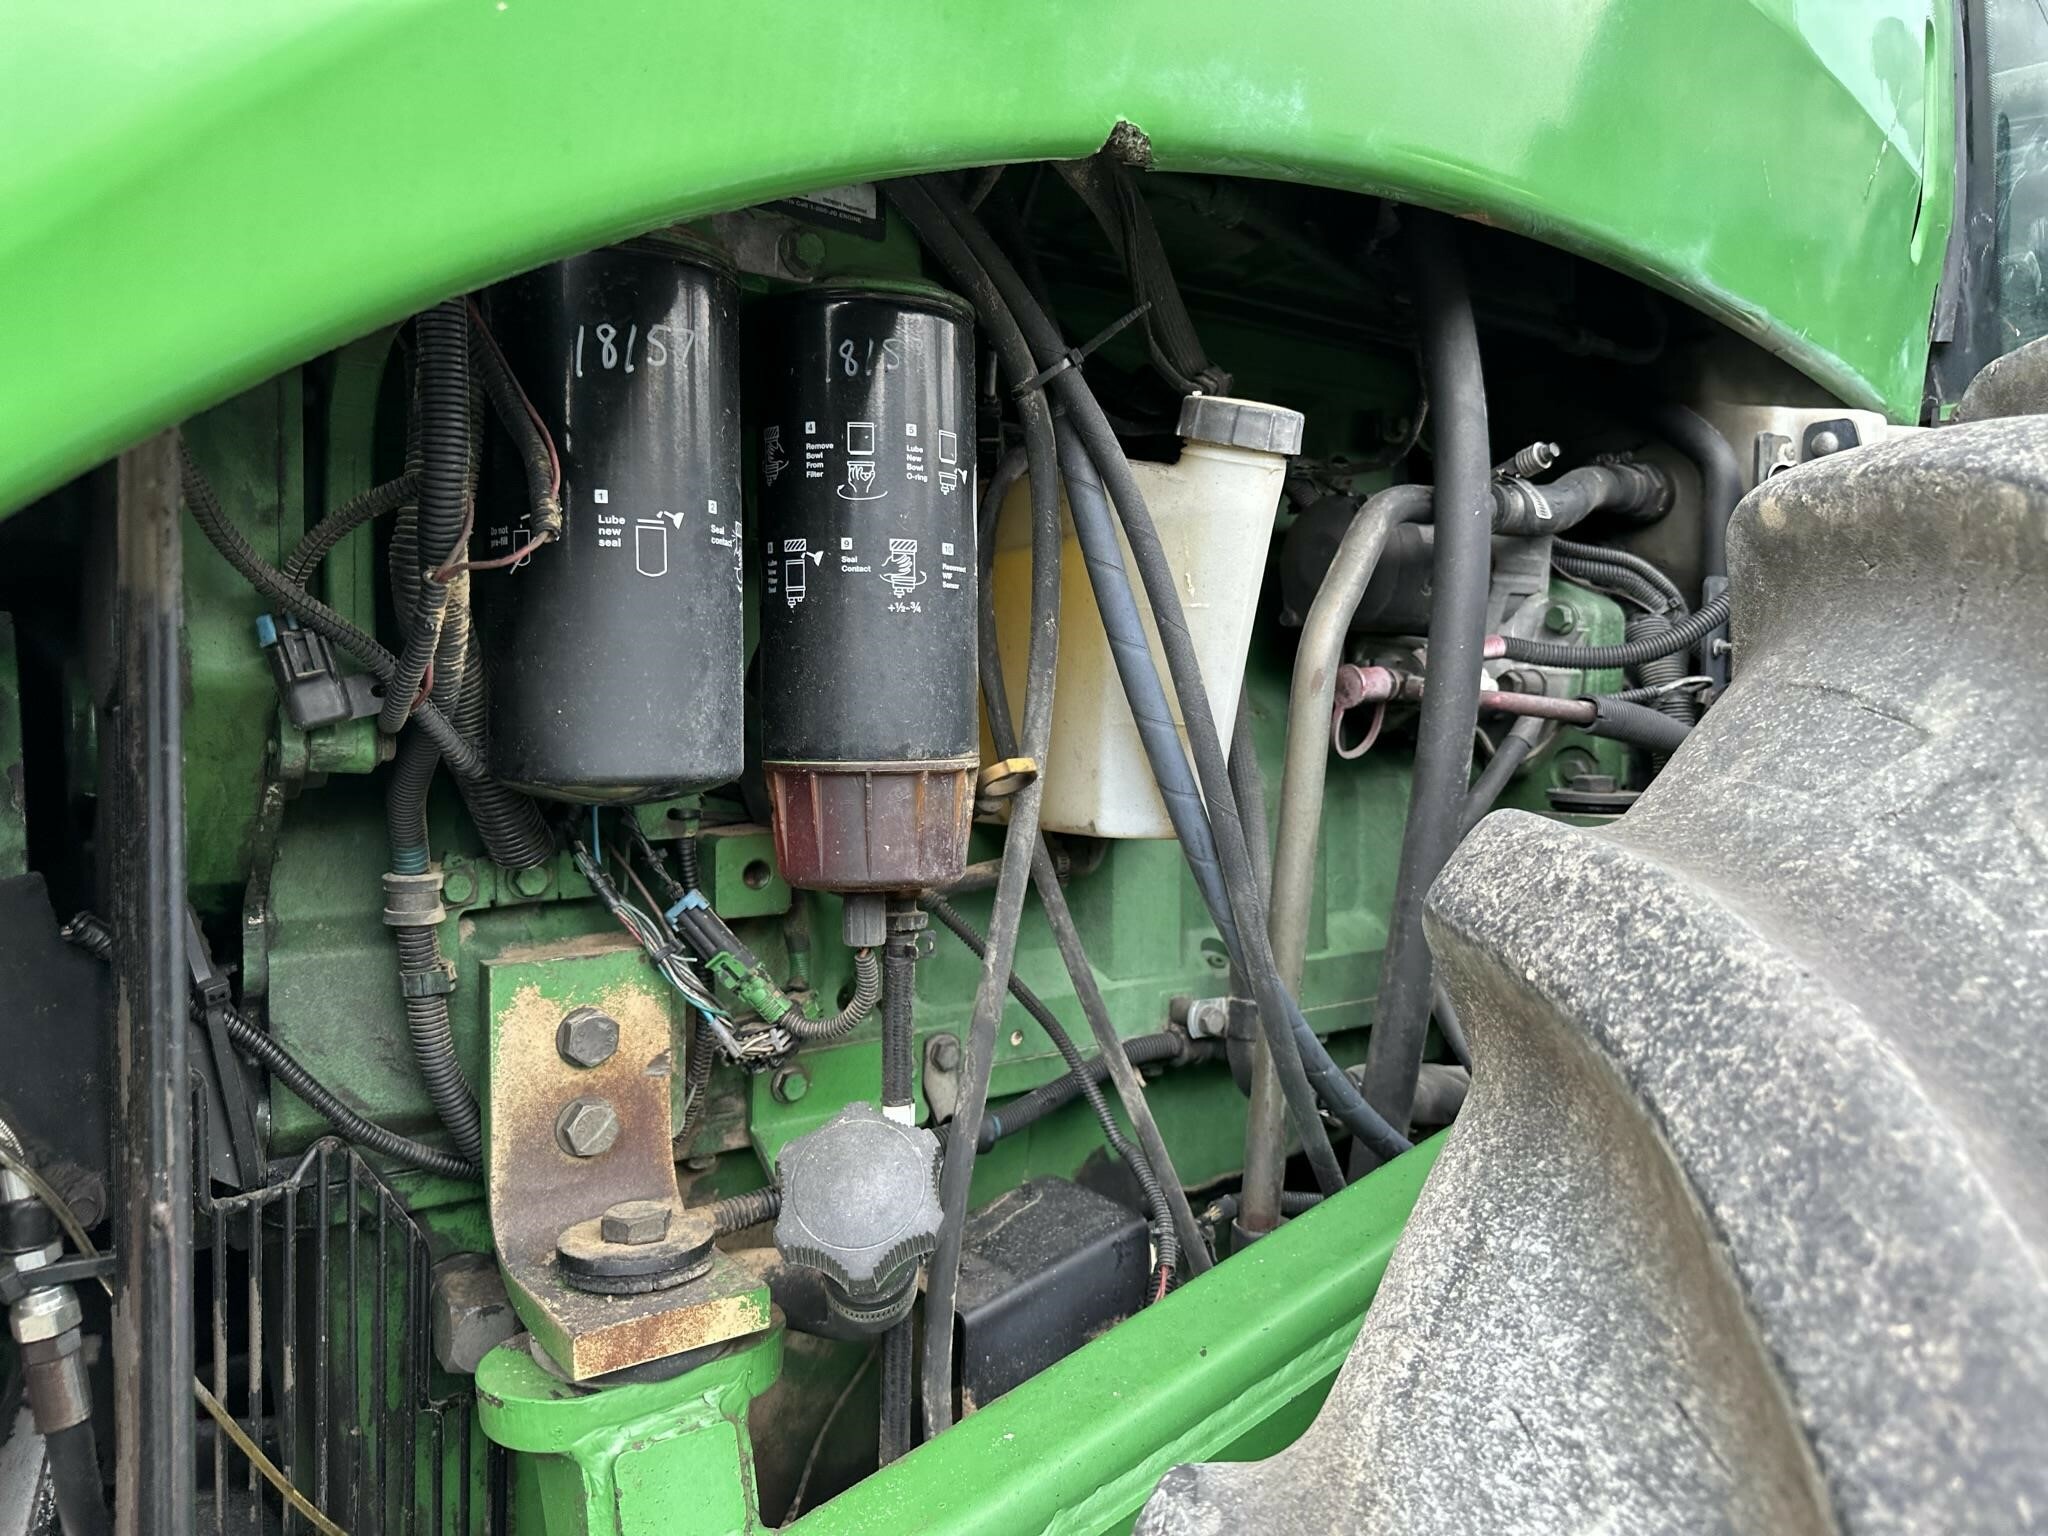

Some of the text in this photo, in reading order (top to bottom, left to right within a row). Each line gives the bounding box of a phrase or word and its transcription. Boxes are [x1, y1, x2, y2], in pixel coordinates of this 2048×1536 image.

[576, 323, 695, 378] 18157
[906, 445, 924, 453] Lube
[805, 452, 824, 460] Bowl
[906, 463, 924, 472] Bowl
[906, 473, 928, 483] O-ring
[597, 514, 626, 525] Lube
[598, 527, 622, 536] new
[710, 524, 725, 534] Seal
[598, 538, 622, 547] seal
[841, 555, 858, 563] Seal
[841, 565, 872, 573] Contact
